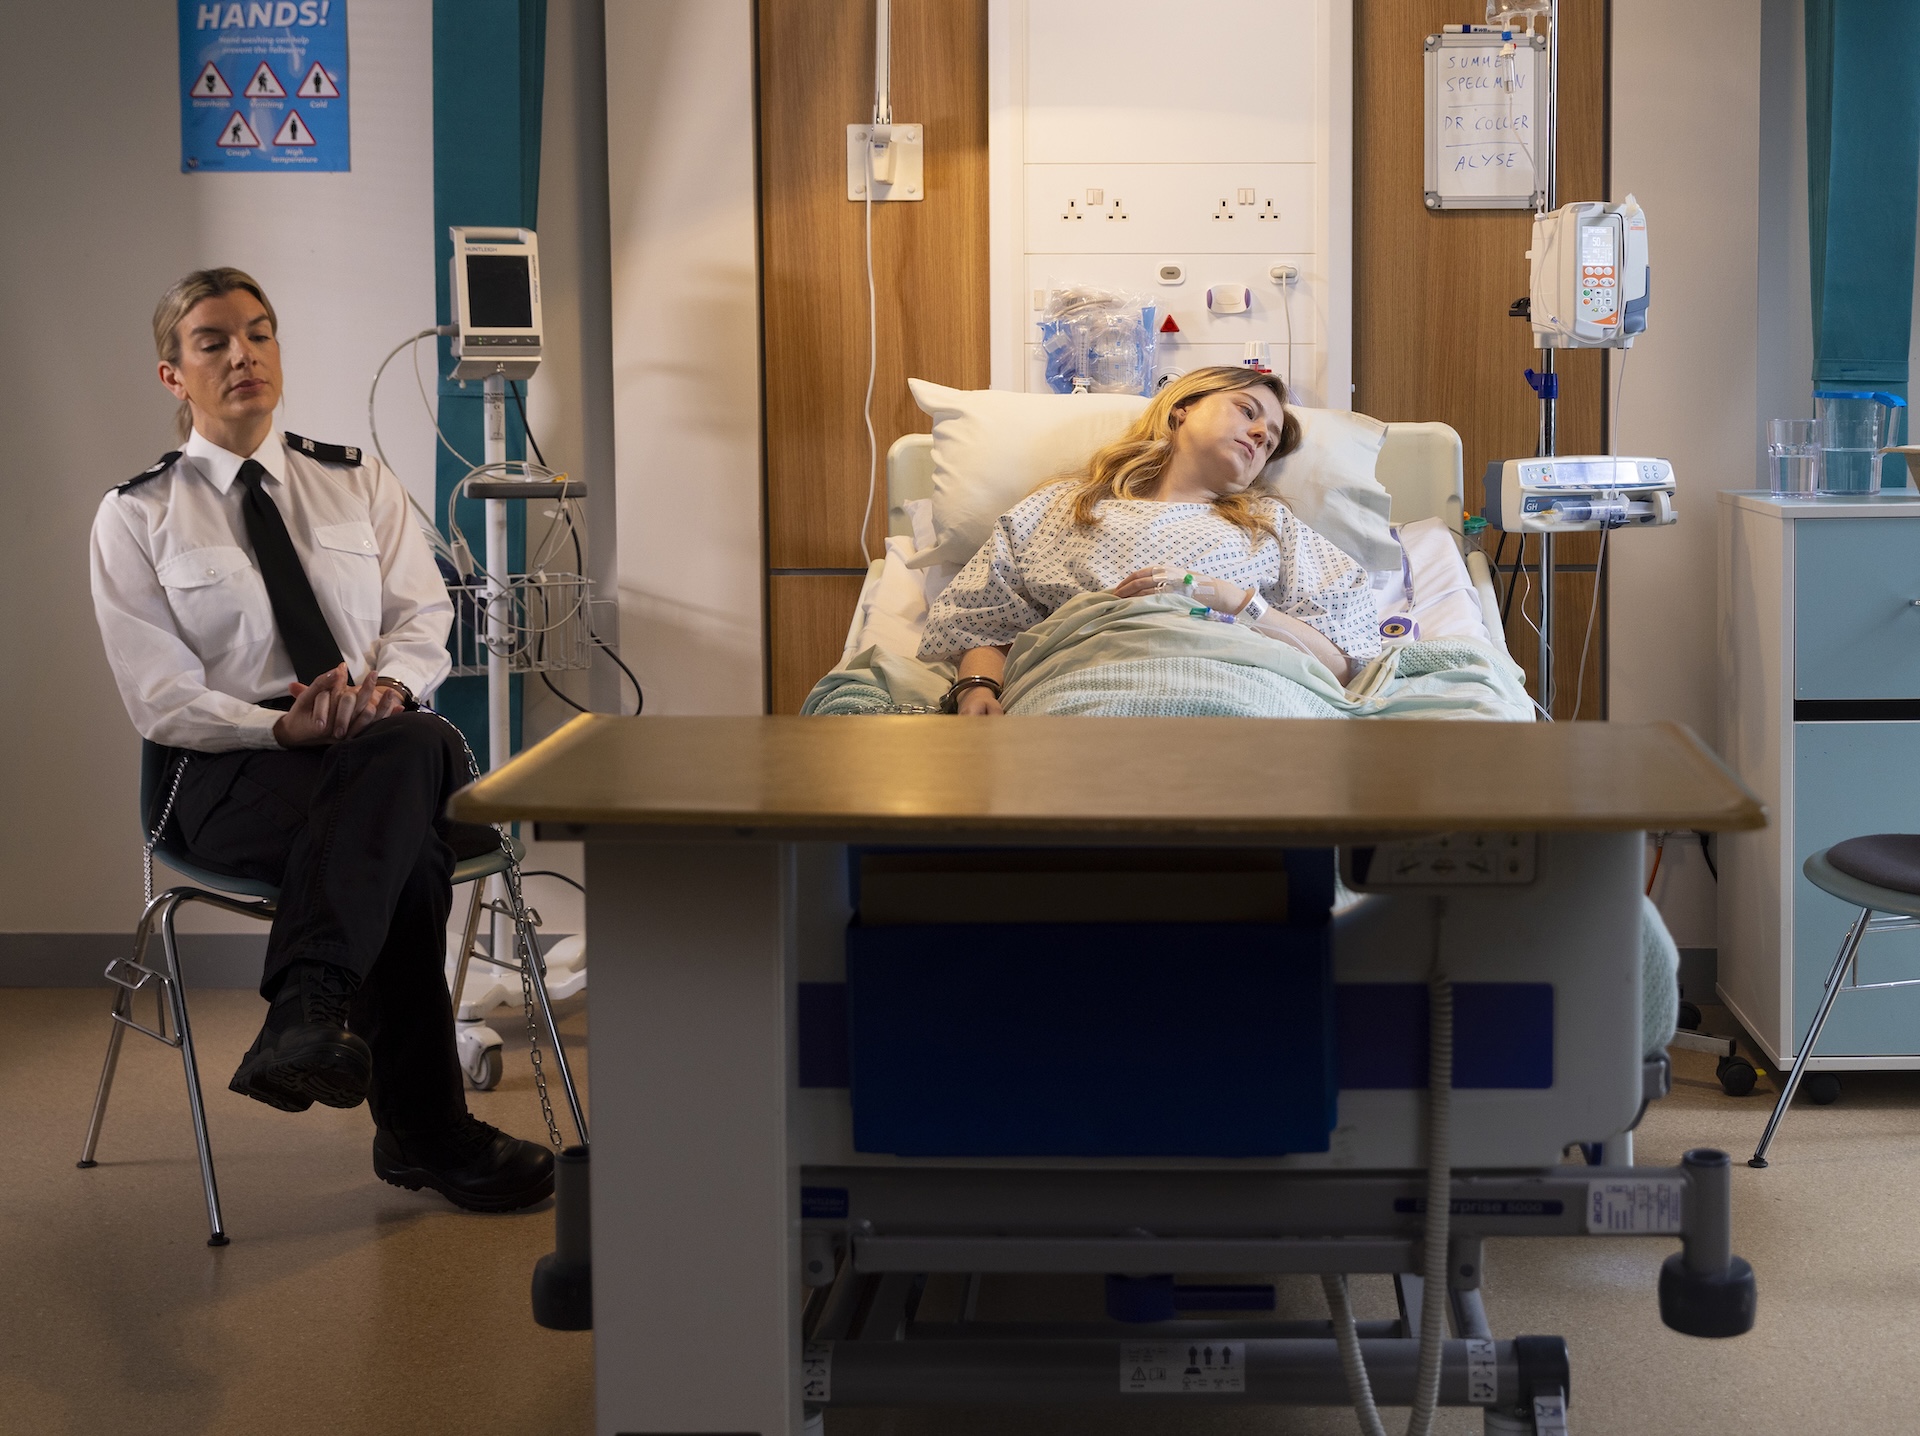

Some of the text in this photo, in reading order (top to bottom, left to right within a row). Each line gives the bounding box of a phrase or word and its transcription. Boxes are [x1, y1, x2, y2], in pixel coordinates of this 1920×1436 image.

[197, 1, 330, 30] HANDS!
[1448, 55, 1504, 69] SUMME
[1446, 74, 1526, 92] SPELLMN
[309, 100, 328, 108] Cold
[1444, 116, 1465, 131] DR
[225, 148, 251, 157] Cough
[285, 148, 304, 157] High
[1454, 152, 1519, 172] ALYSE
[1526, 502, 1538, 511] GH
[1416, 1199, 1502, 1213] Erprise
